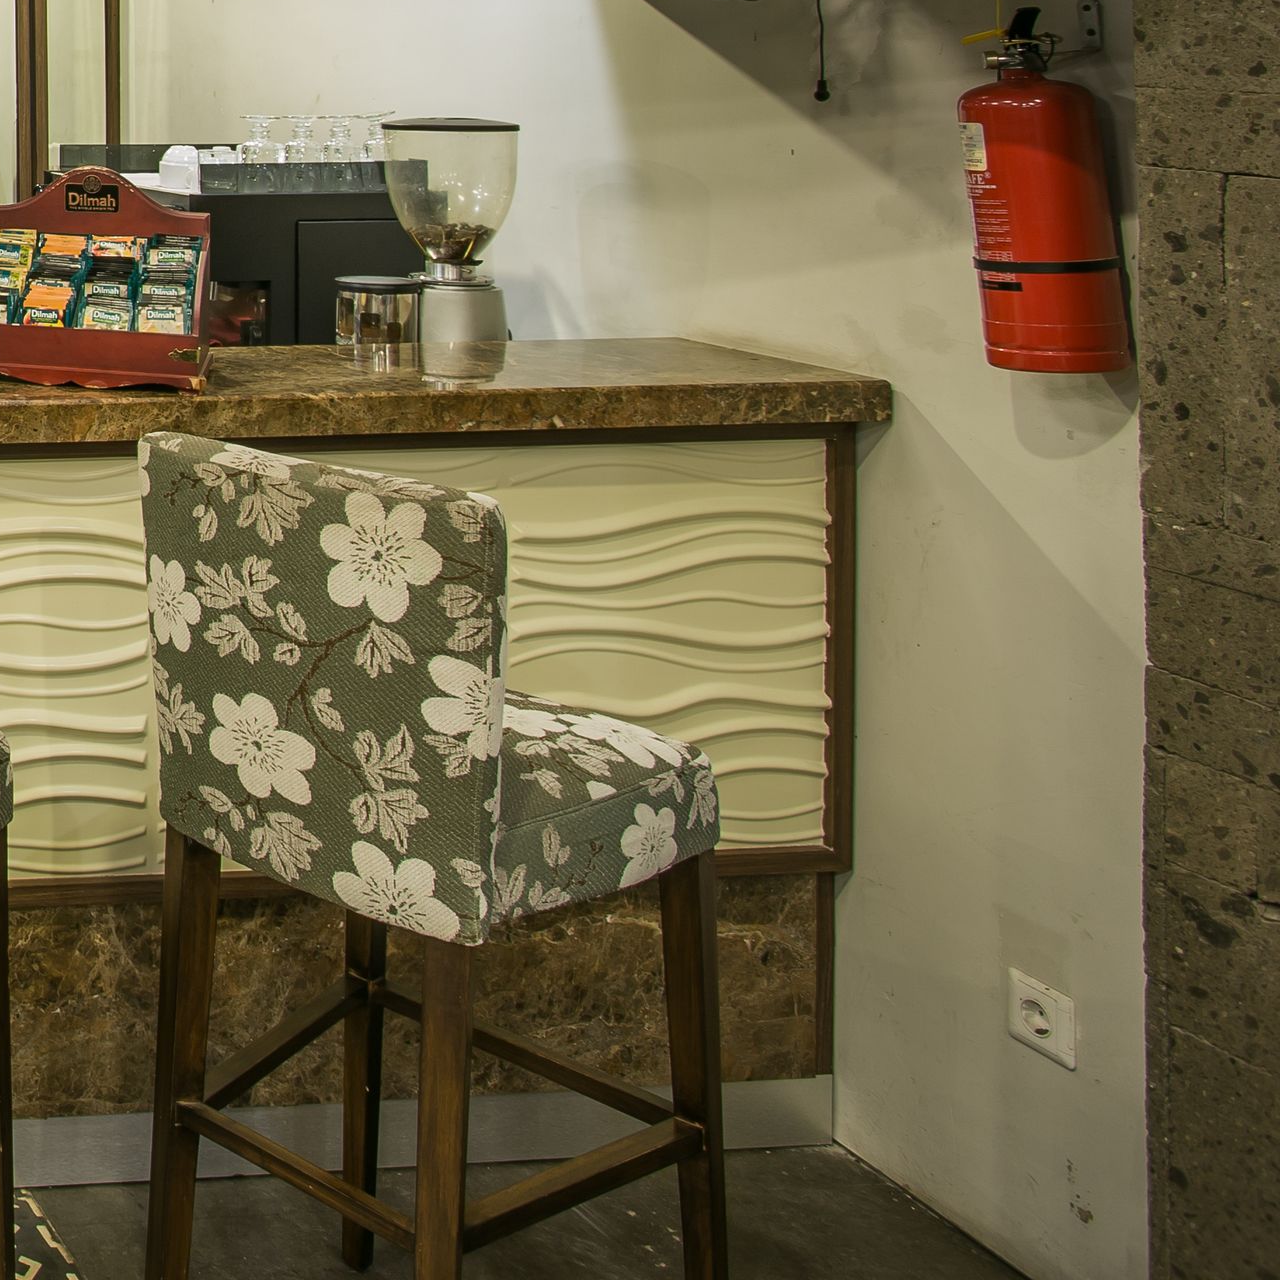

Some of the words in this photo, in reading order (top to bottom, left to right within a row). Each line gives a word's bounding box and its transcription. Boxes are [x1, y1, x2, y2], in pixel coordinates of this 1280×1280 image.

[68, 192, 116, 207] Dilmah
[158, 251, 185, 259] Dilmah
[92, 285, 120, 294] Dilmah
[150, 287, 178, 296] Dilmah
[31, 309, 58, 319] Dilmah
[93, 310, 120, 322] Dilmah
[147, 310, 175, 319] Dilmah
